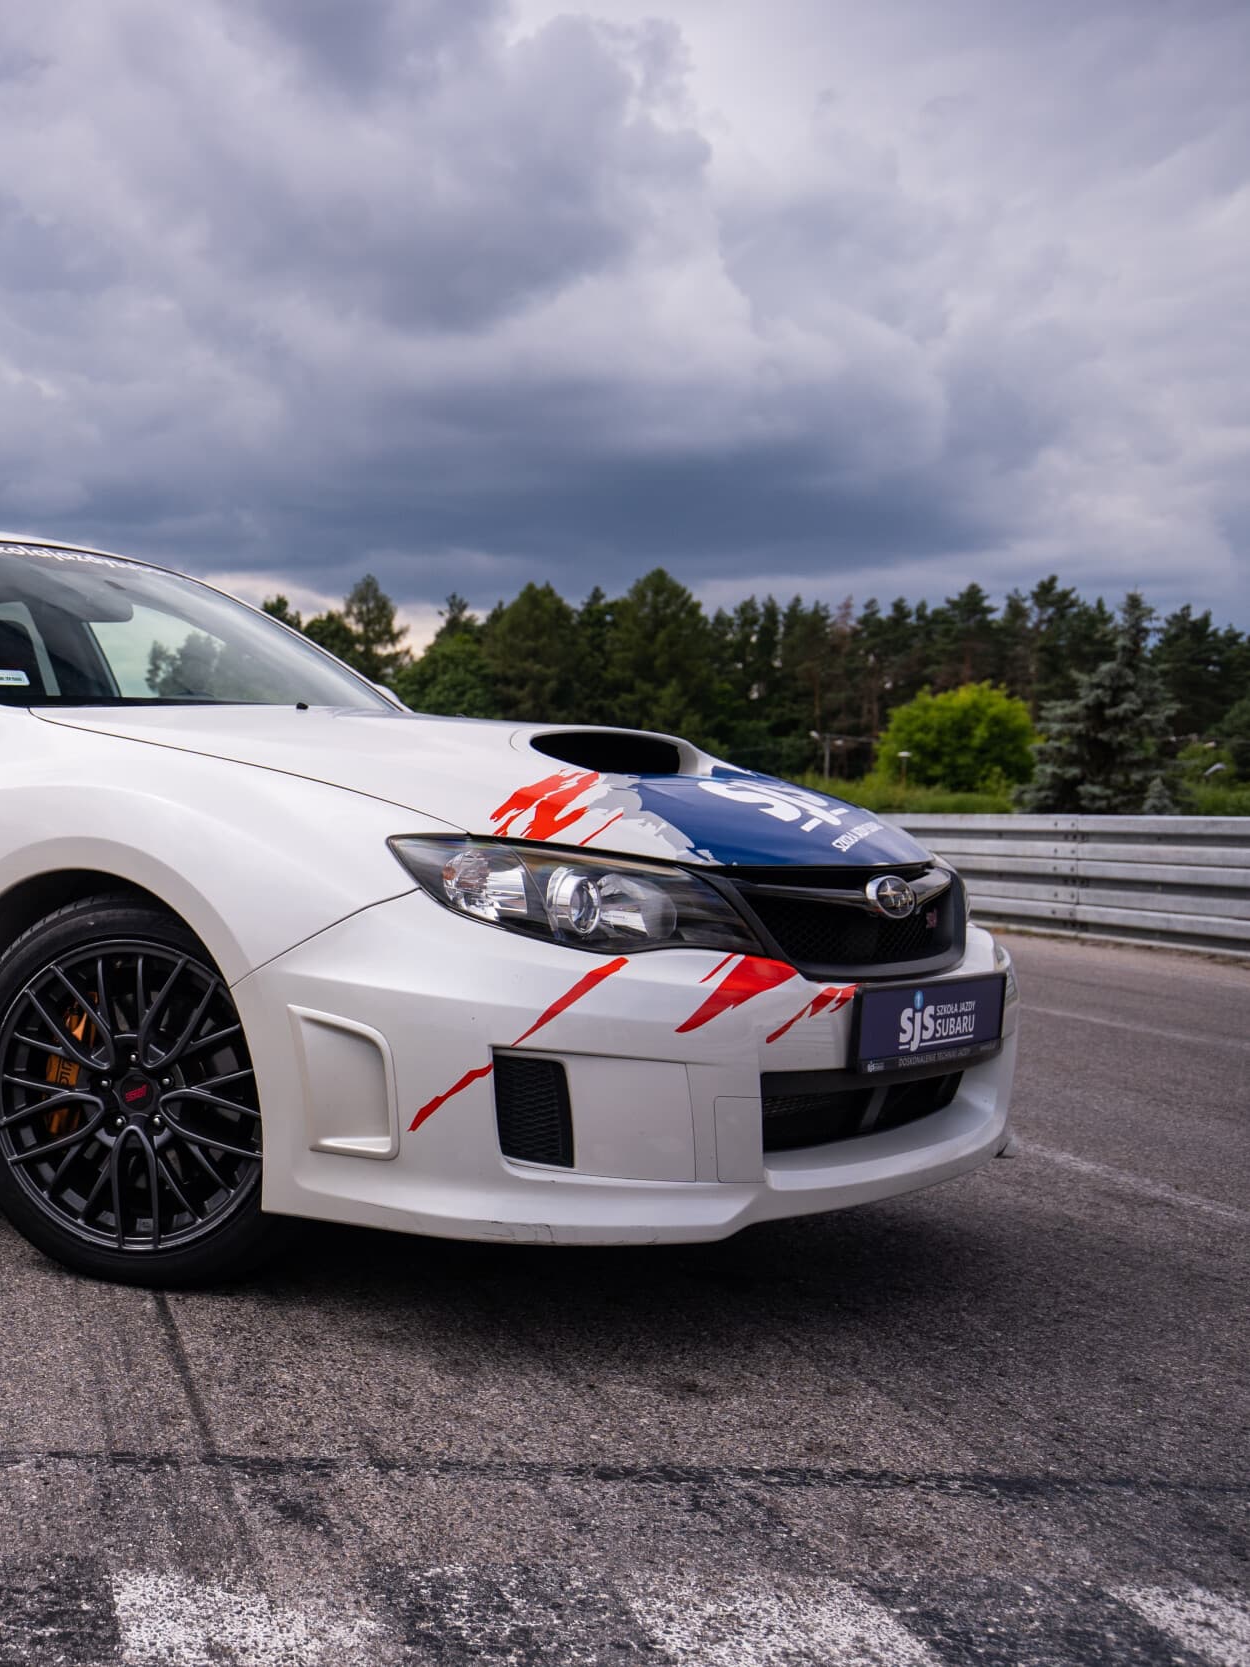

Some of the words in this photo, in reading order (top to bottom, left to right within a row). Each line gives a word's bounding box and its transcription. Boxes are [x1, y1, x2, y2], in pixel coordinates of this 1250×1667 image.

[936, 1003, 959, 1016] SZKOŁA
[959, 1000, 976, 1013] JAZDY
[935, 1014, 975, 1038] SUBARU
